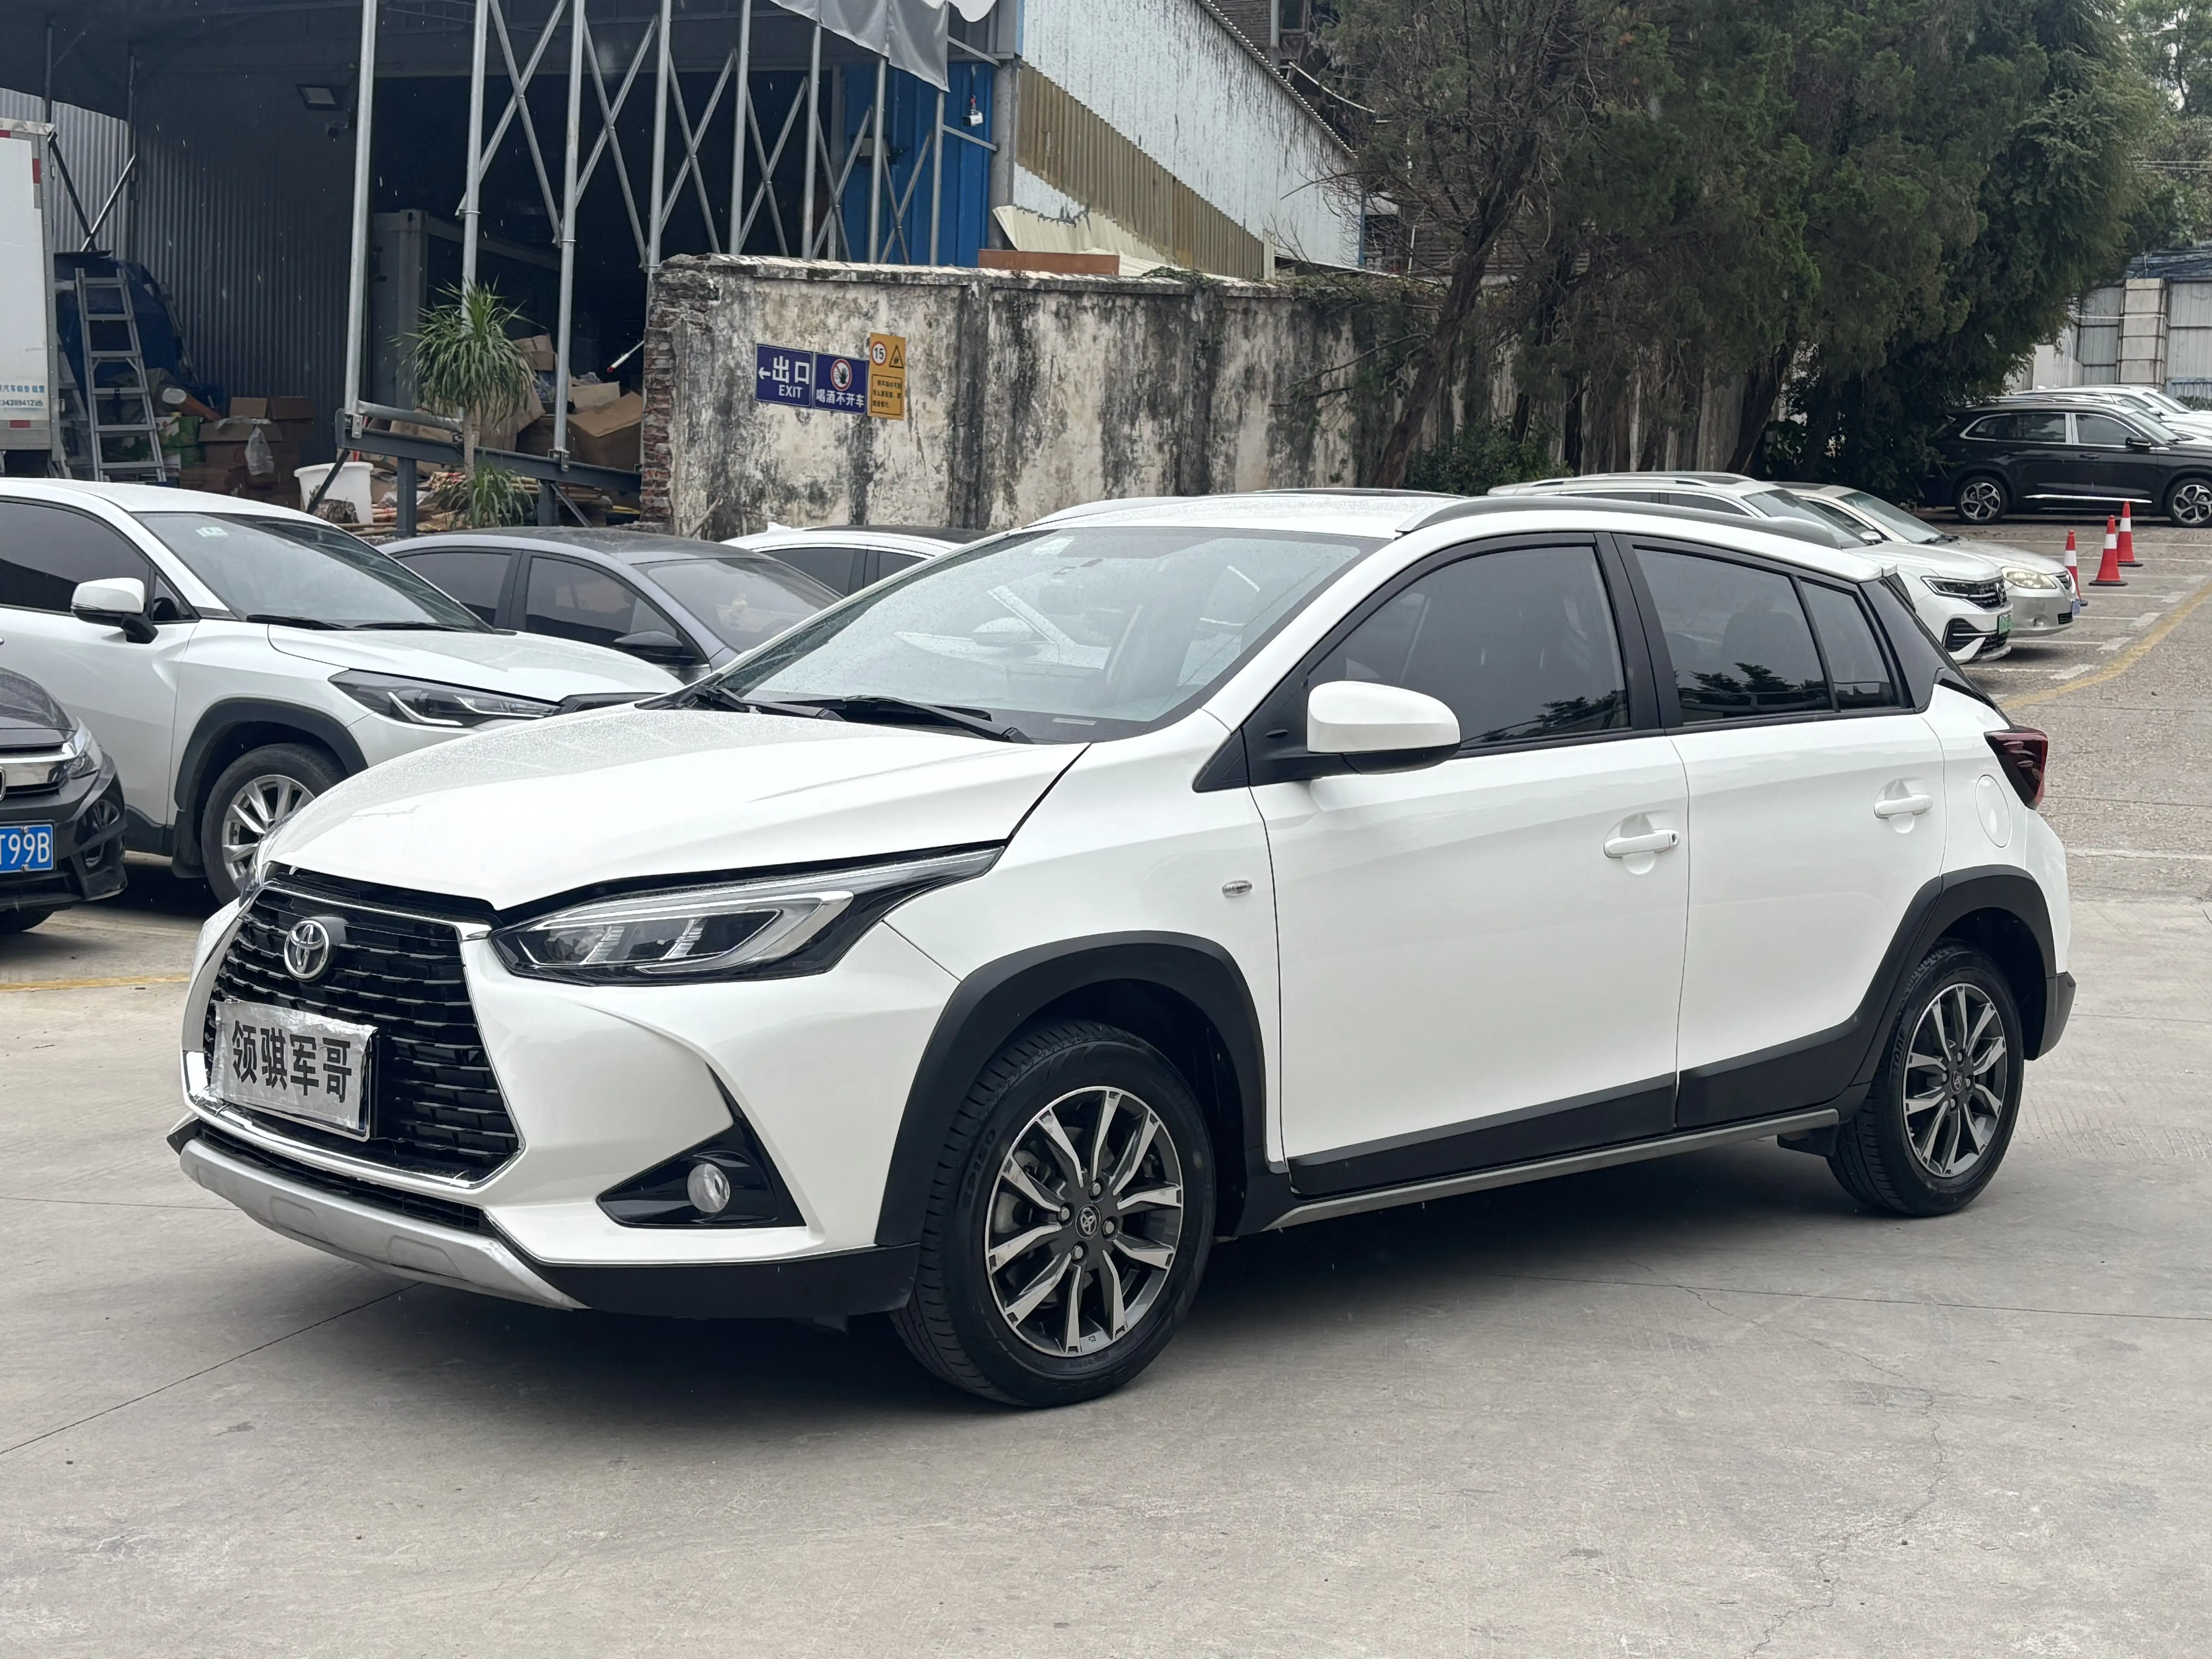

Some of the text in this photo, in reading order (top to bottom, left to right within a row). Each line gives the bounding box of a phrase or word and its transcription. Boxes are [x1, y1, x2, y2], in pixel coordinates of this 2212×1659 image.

[874, 348, 884, 359] 15
[772, 356, 809, 384] 出口
[779, 385, 802, 398] EXIT
[816, 389, 864, 408] 喝酒不开车
[232, 1020, 352, 1103] 领骐军哥
